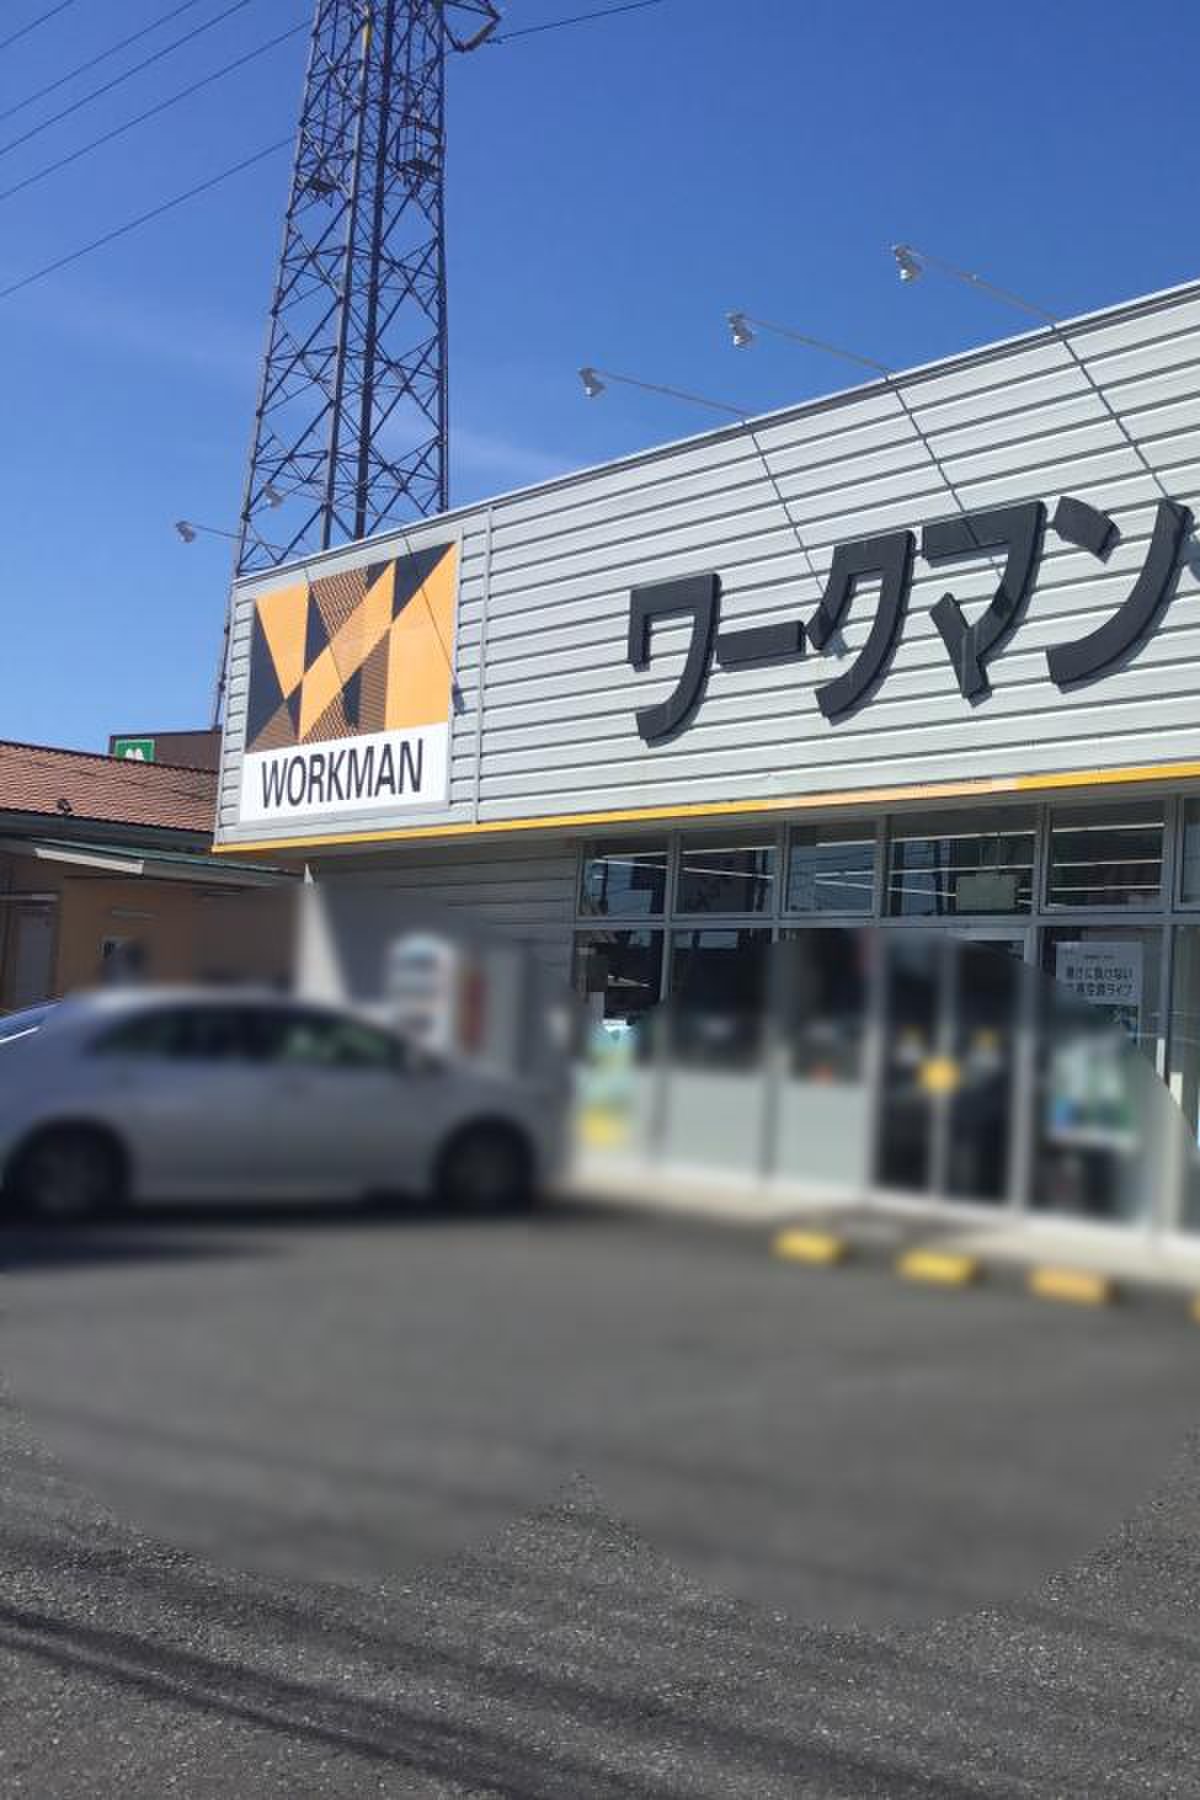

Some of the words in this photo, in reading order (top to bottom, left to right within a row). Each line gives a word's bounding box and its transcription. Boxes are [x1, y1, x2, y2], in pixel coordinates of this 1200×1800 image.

[627, 496, 1193, 742] ワークマン
[262, 738, 423, 808] WORKMAN
